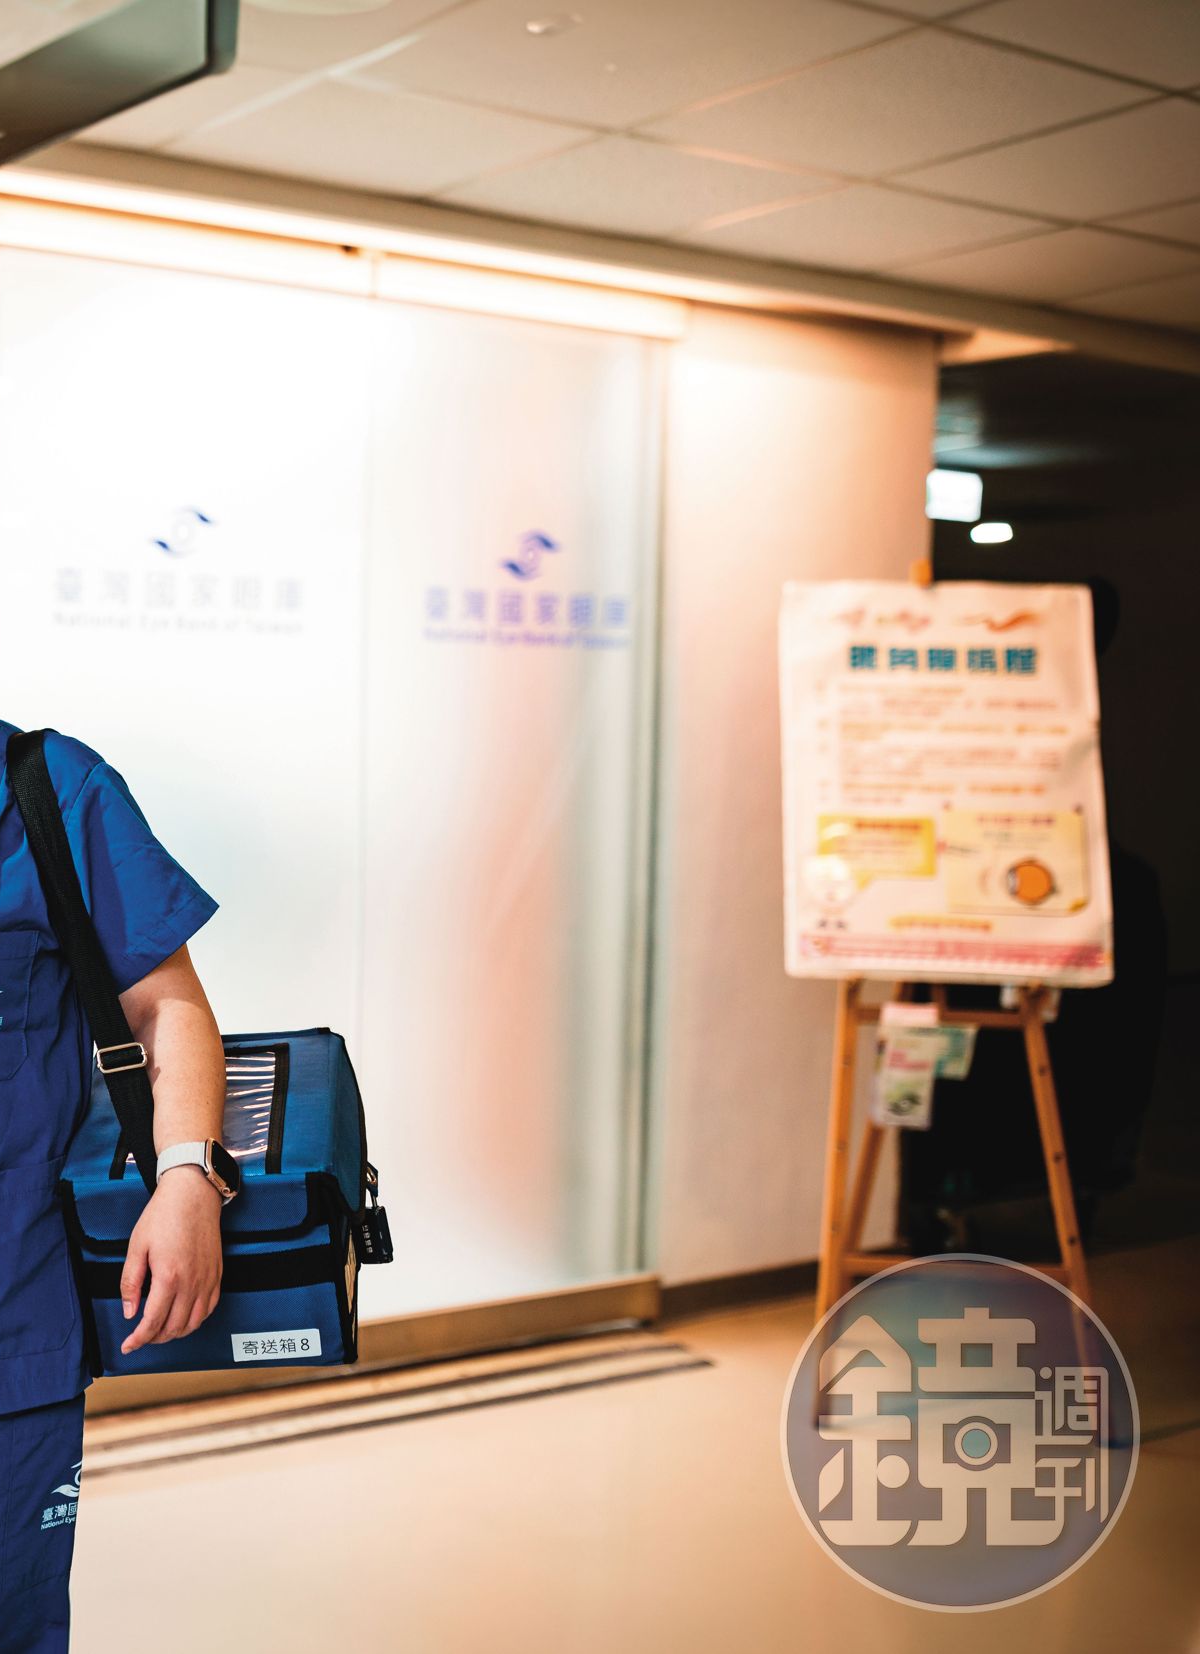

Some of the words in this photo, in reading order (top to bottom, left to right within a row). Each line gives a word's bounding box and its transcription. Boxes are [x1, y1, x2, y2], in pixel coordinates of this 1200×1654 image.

[242, 1338, 297, 1355] 寄送箱
[300, 1338, 310, 1351] 8
[40, 1518, 65, 1530] National
